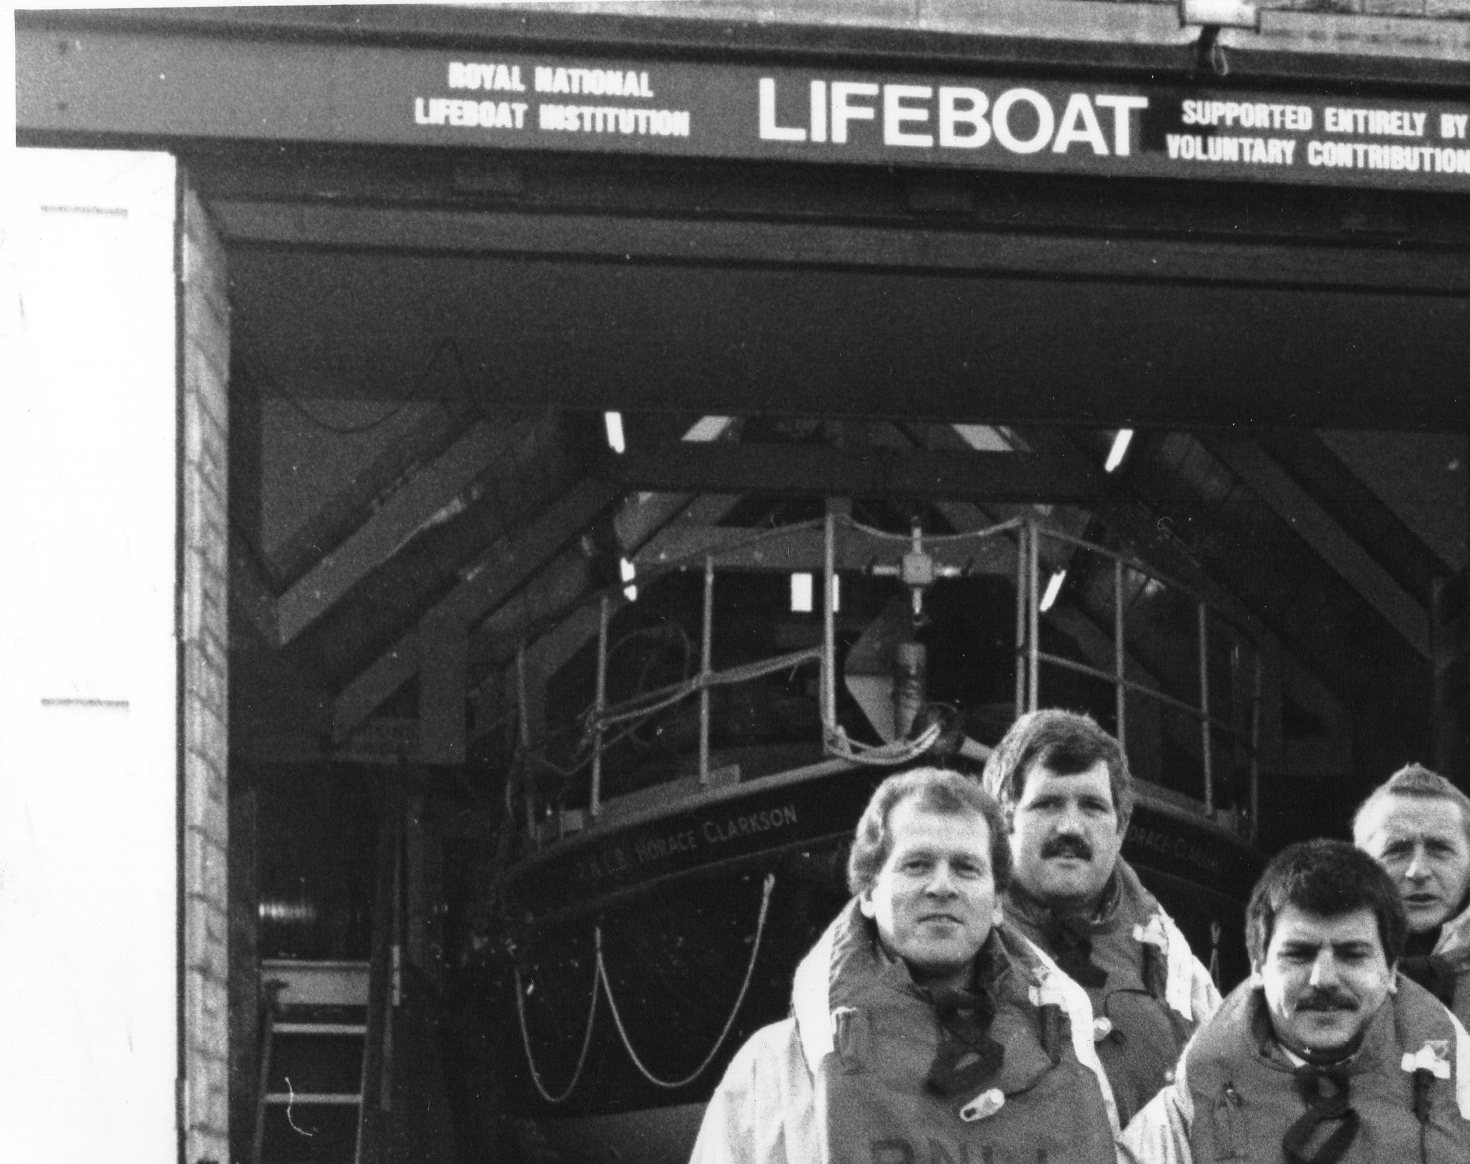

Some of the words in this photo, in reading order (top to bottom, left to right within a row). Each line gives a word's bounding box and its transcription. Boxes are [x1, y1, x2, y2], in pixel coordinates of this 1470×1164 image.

[449, 62, 525, 91] ROYAL
[535, 66, 654, 97] NATIONAL
[415, 97, 528, 128] LIFEBOAT
[539, 104, 690, 137] INSTITUTION
[759, 78, 1148, 157] LIFEBOAT
[1182, 100, 1312, 131] SUPPORTED
[1325, 107, 1425, 137] ENTIRELY
[1440, 114, 1468, 138] BY
[1166, 133, 1295, 165] VOLUNTARY
[635, 829, 698, 864] HORACE
[702, 803, 798, 844] CLARKSON
